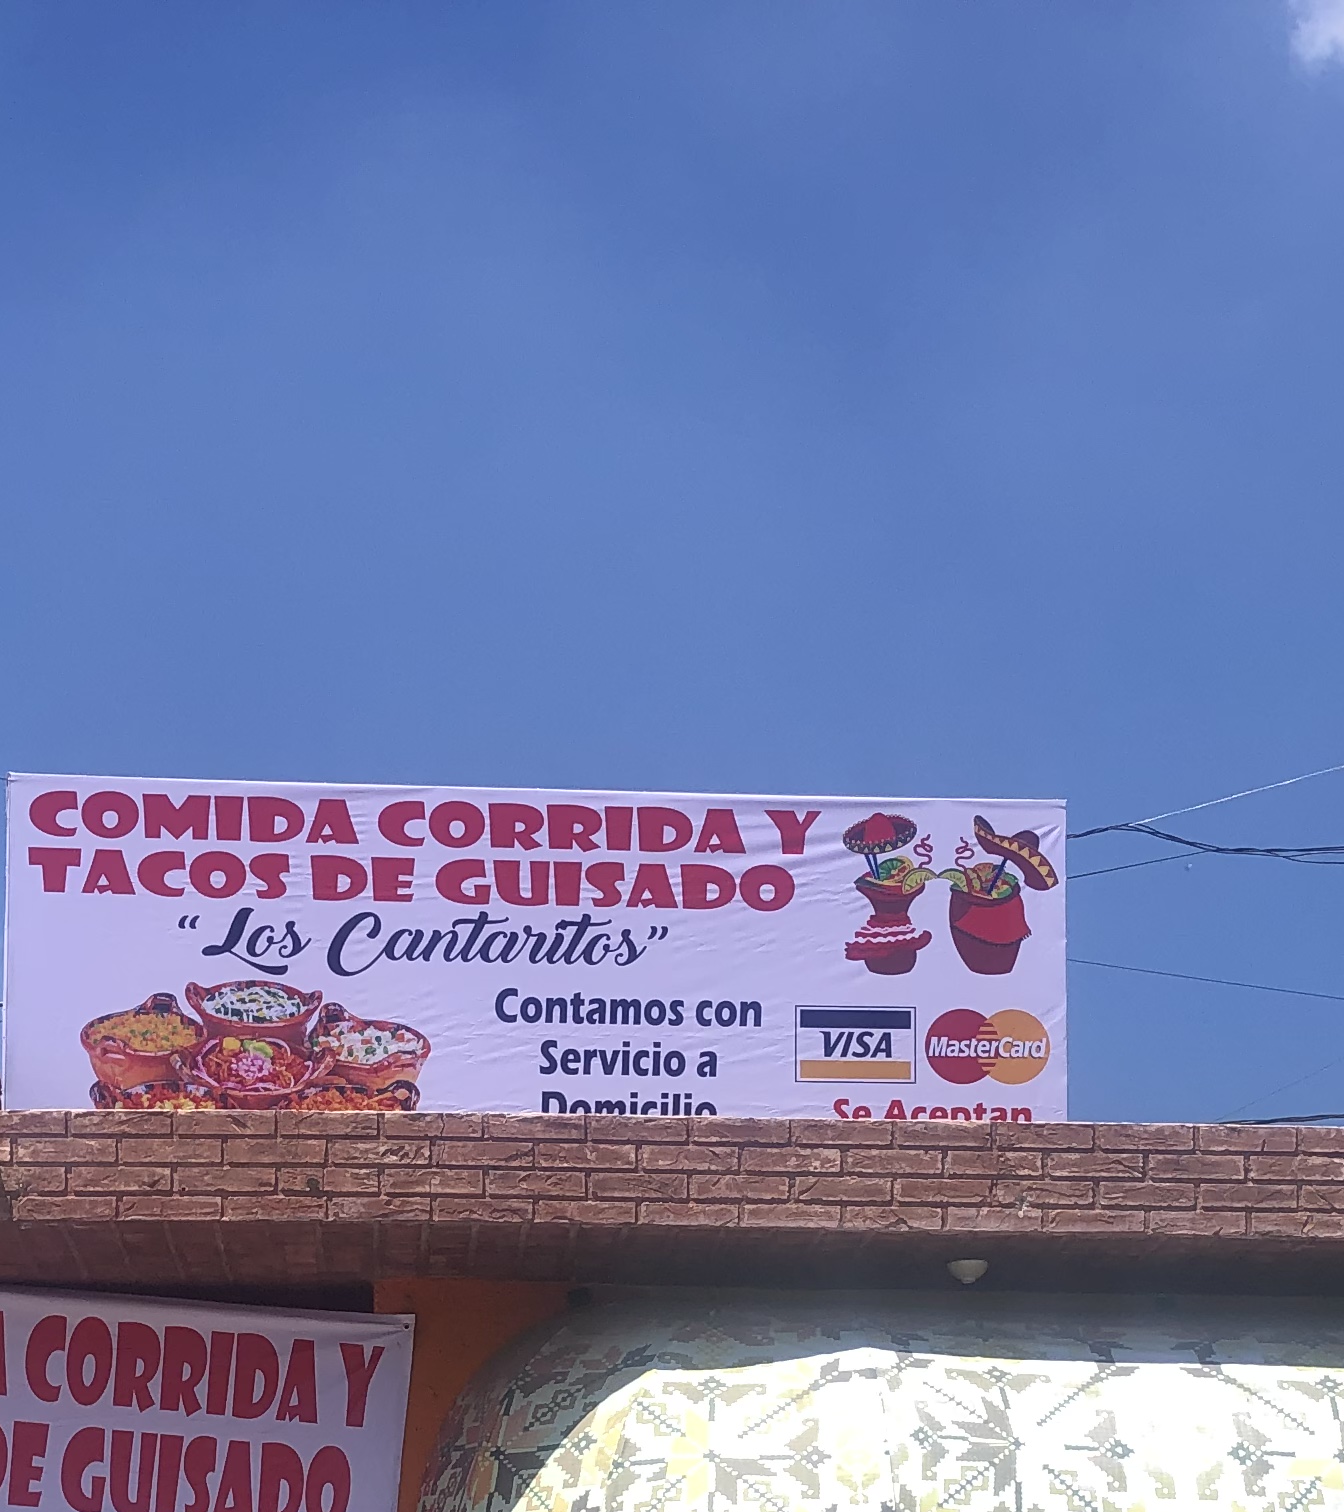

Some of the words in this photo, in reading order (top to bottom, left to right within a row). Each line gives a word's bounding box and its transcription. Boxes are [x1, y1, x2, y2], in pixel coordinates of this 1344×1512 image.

[29, 790, 359, 845] COMIDA
[377, 800, 746, 854] CORRIDA
[766, 810, 819, 856] Y
[28, 846, 290, 900] TACOS
[310, 854, 415, 903] DE
[434, 858, 795, 912] GUISADO
[177, 907, 312, 976] “Los
[326, 910, 669, 977] Cantaritos”
[494, 987, 685, 1027] Contamos
[695, 999, 762, 1028] con
[539, 1039, 686, 1078] Servicio
[696, 1050, 718, 1078] a
[818, 1030, 893, 1059] VISA
[927, 1036, 1047, 1059] MasterCard
[25, 1314, 318, 1424] CORRIDA
[340, 1342, 385, 1427] Y
